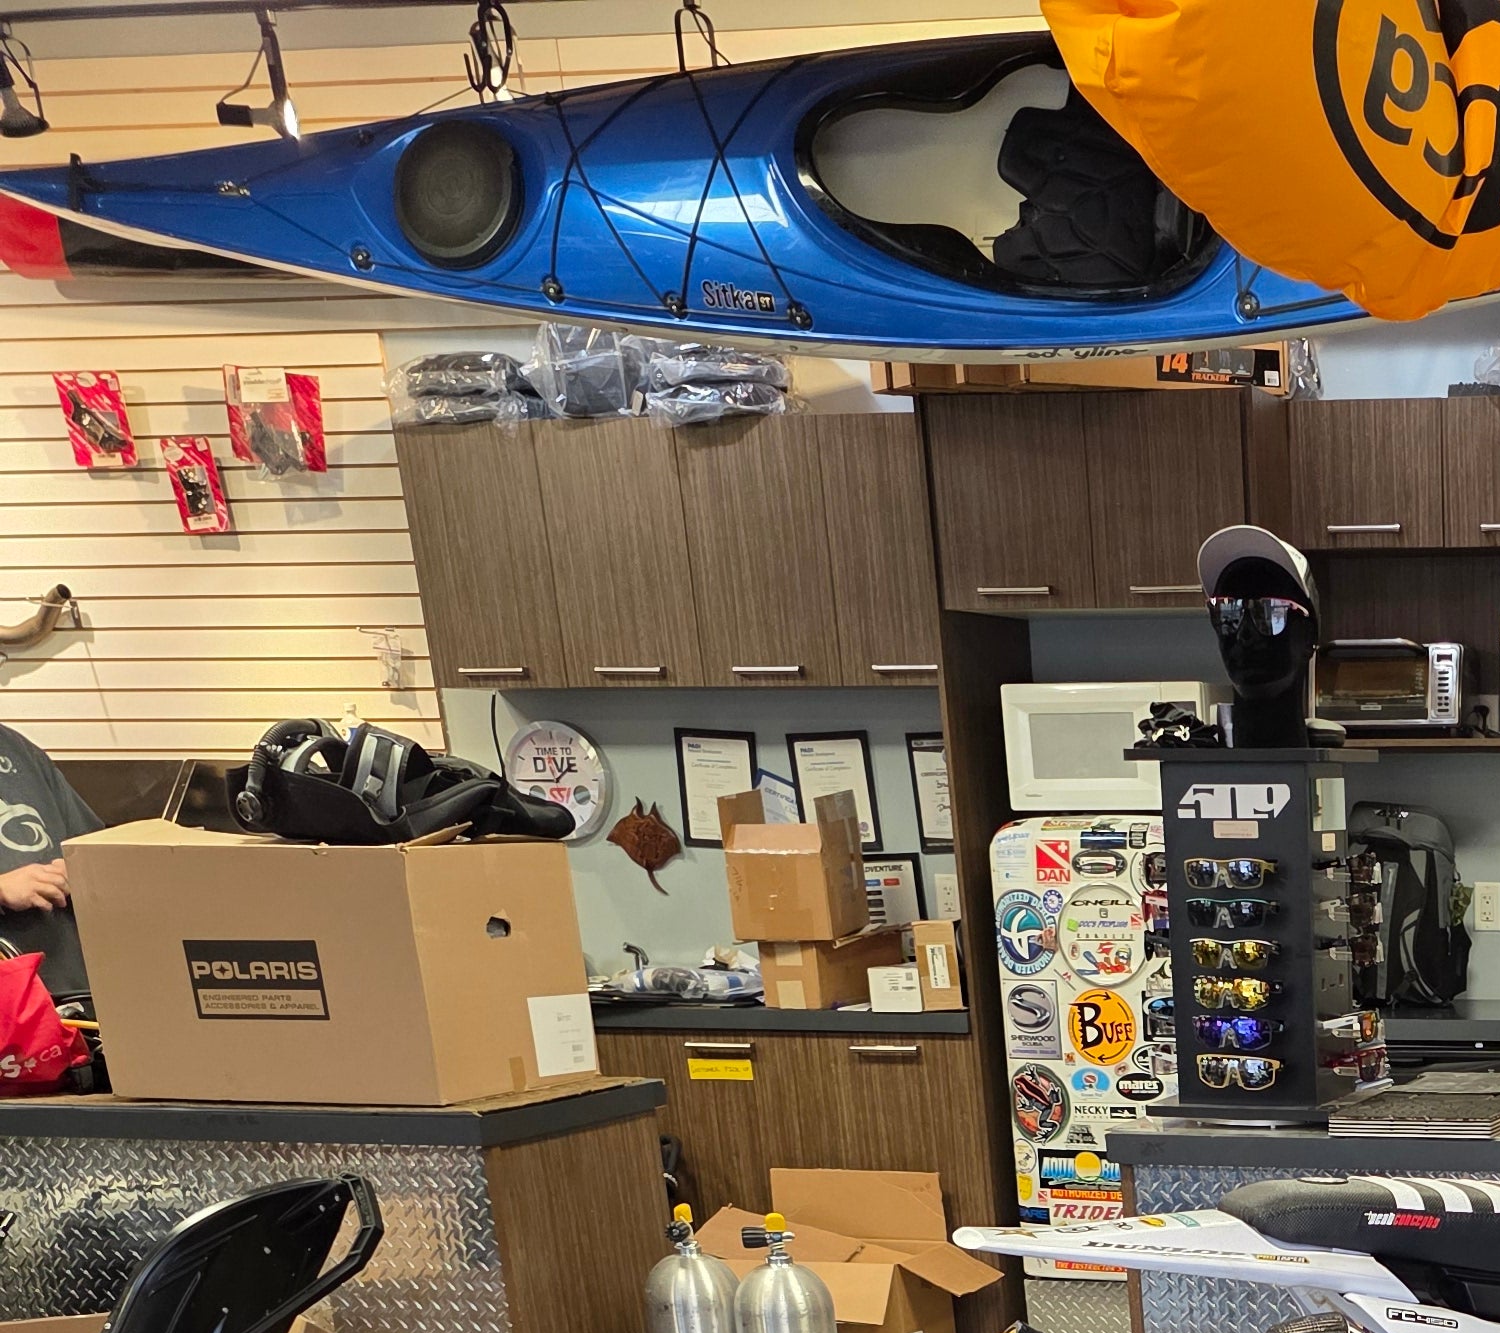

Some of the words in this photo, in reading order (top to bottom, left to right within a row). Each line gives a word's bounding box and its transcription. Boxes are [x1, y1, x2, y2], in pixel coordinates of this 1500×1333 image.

[701, 279, 757, 310] Sitka
[760, 296, 772, 308] ST
[535, 747, 558, 756] TIME
[561, 747, 572, 756] TO
[533, 756, 578, 773] DIVE
[1036, 869, 1070, 882] DAN
[191, 961, 318, 980] POLARIS
[202, 994, 259, 1002] ENGINEERED
[261, 994, 292, 1002] PARTS
[205, 1002, 267, 1010] ACCESSORIES
[1010, 1034, 1056, 1042] SHERWOOD
[1118, 1079, 1160, 1091] mares
[1074, 1105, 1109, 1114] NECKY
[1041, 1156, 1075, 1179] AQUA
[1052, 1188, 1108, 1199] AUTHORIZED
